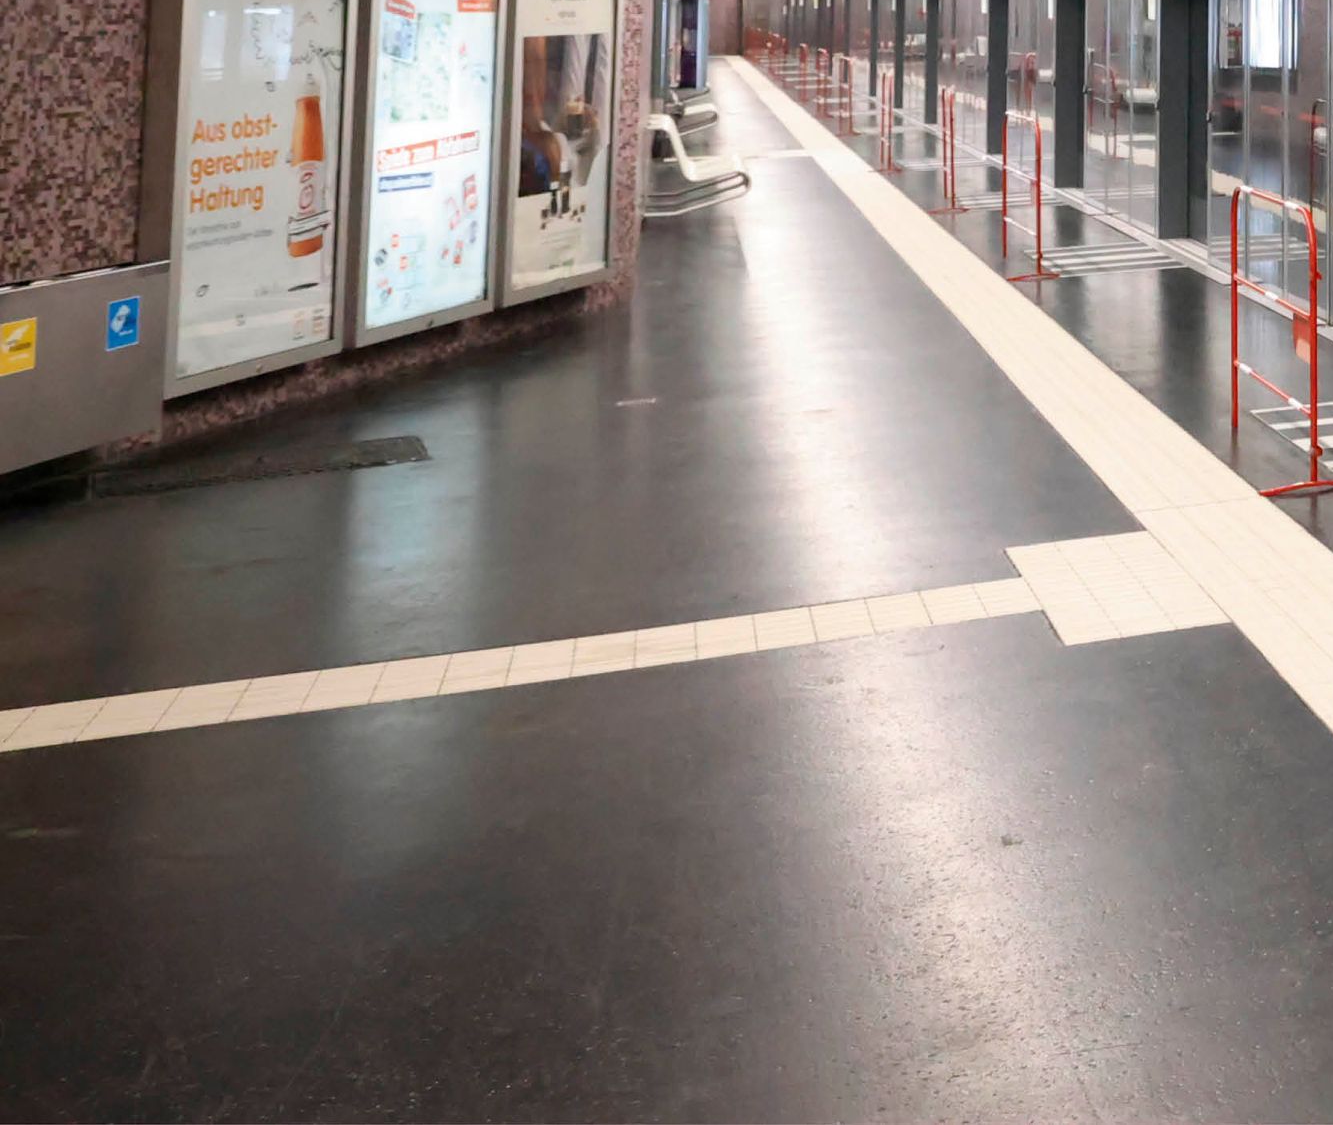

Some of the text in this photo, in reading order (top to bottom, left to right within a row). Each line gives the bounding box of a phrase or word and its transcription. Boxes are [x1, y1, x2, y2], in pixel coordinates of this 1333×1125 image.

[191, 114, 278, 144] Aus obst-
[191, 146, 278, 185] gerechter
[190, 185, 264, 213] Haltung
